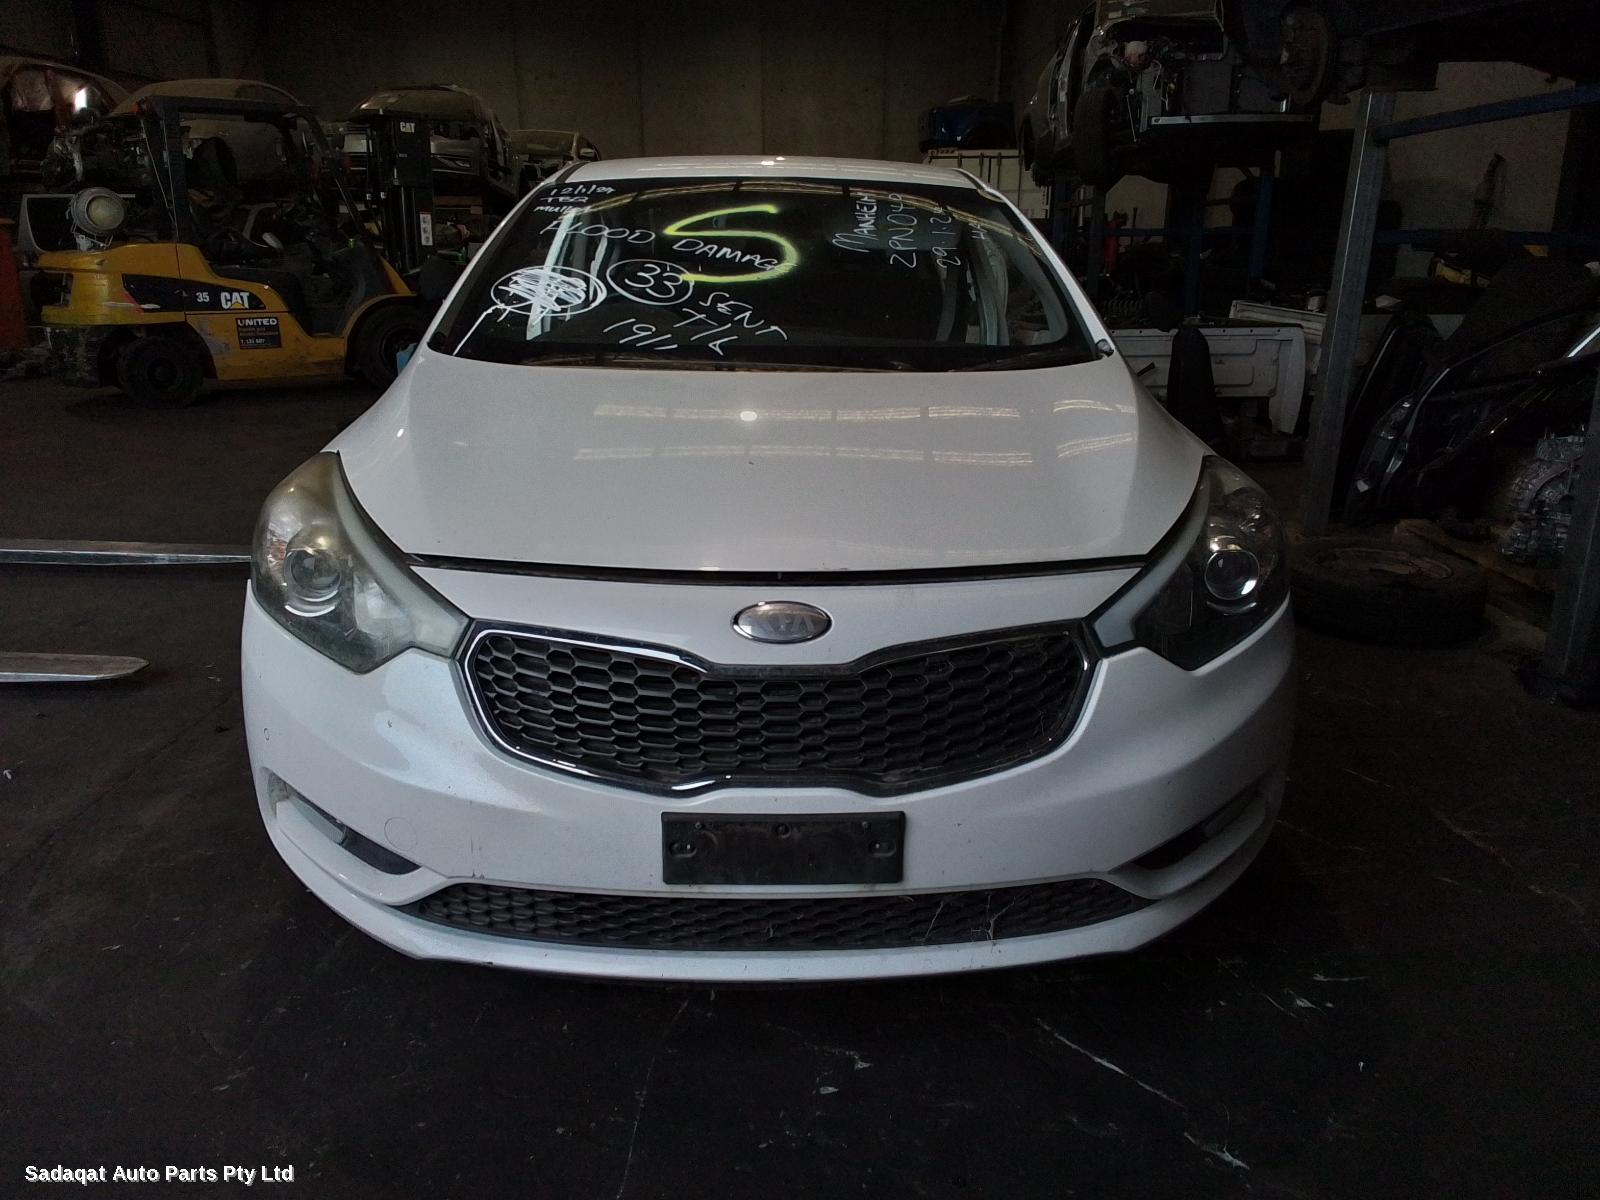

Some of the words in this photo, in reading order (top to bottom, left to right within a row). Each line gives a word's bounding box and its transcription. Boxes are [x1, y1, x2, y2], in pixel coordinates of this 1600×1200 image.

[400, 122, 415, 132] CAT
[540, 220, 656, 244] FLOOD
[624, 263, 685, 298] 33
[196, 291, 210, 303] 35
[220, 291, 250, 309] CAT
[237, 318, 278, 327] UNITED
